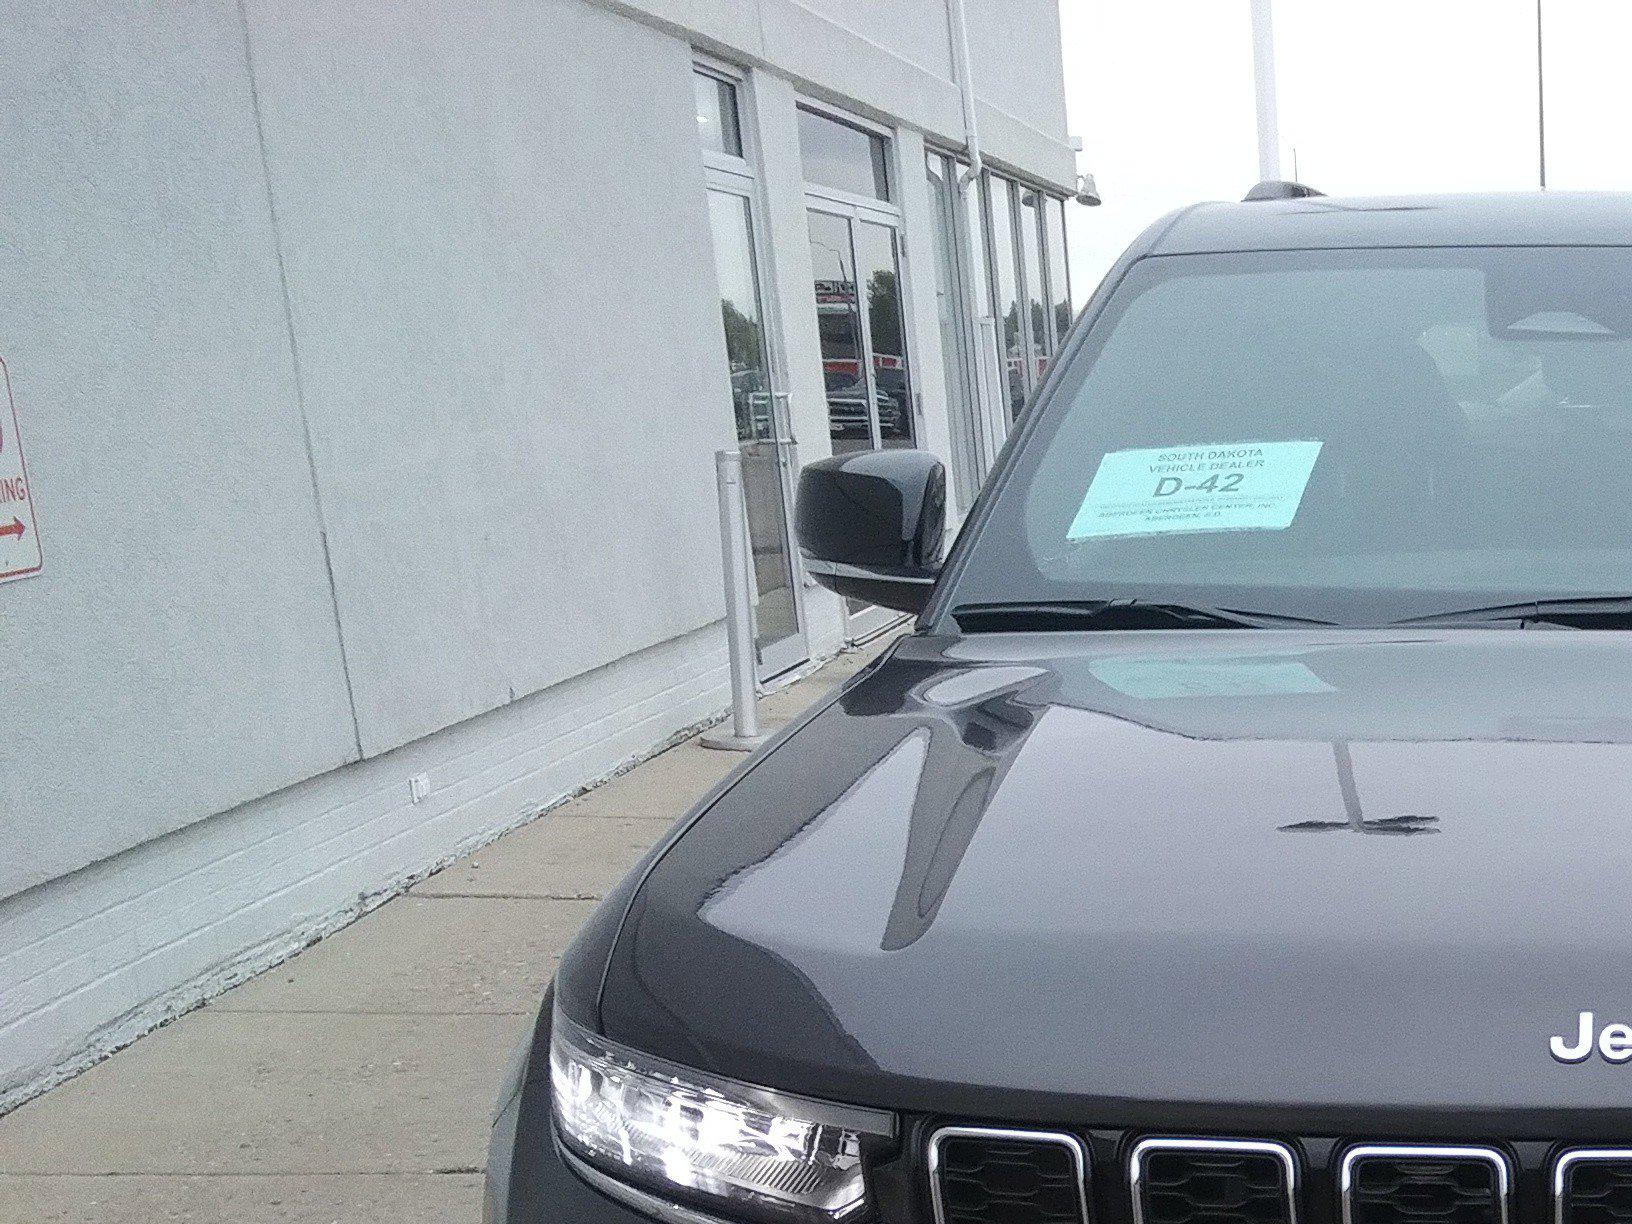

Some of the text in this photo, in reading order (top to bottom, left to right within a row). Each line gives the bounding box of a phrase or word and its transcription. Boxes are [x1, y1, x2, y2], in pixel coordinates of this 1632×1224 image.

[1157, 449, 1263, 463] SOUTH DAKOTA
[1149, 460, 1265, 474] VEHICLE DEALER
[1152, 473, 1245, 498] D-42
